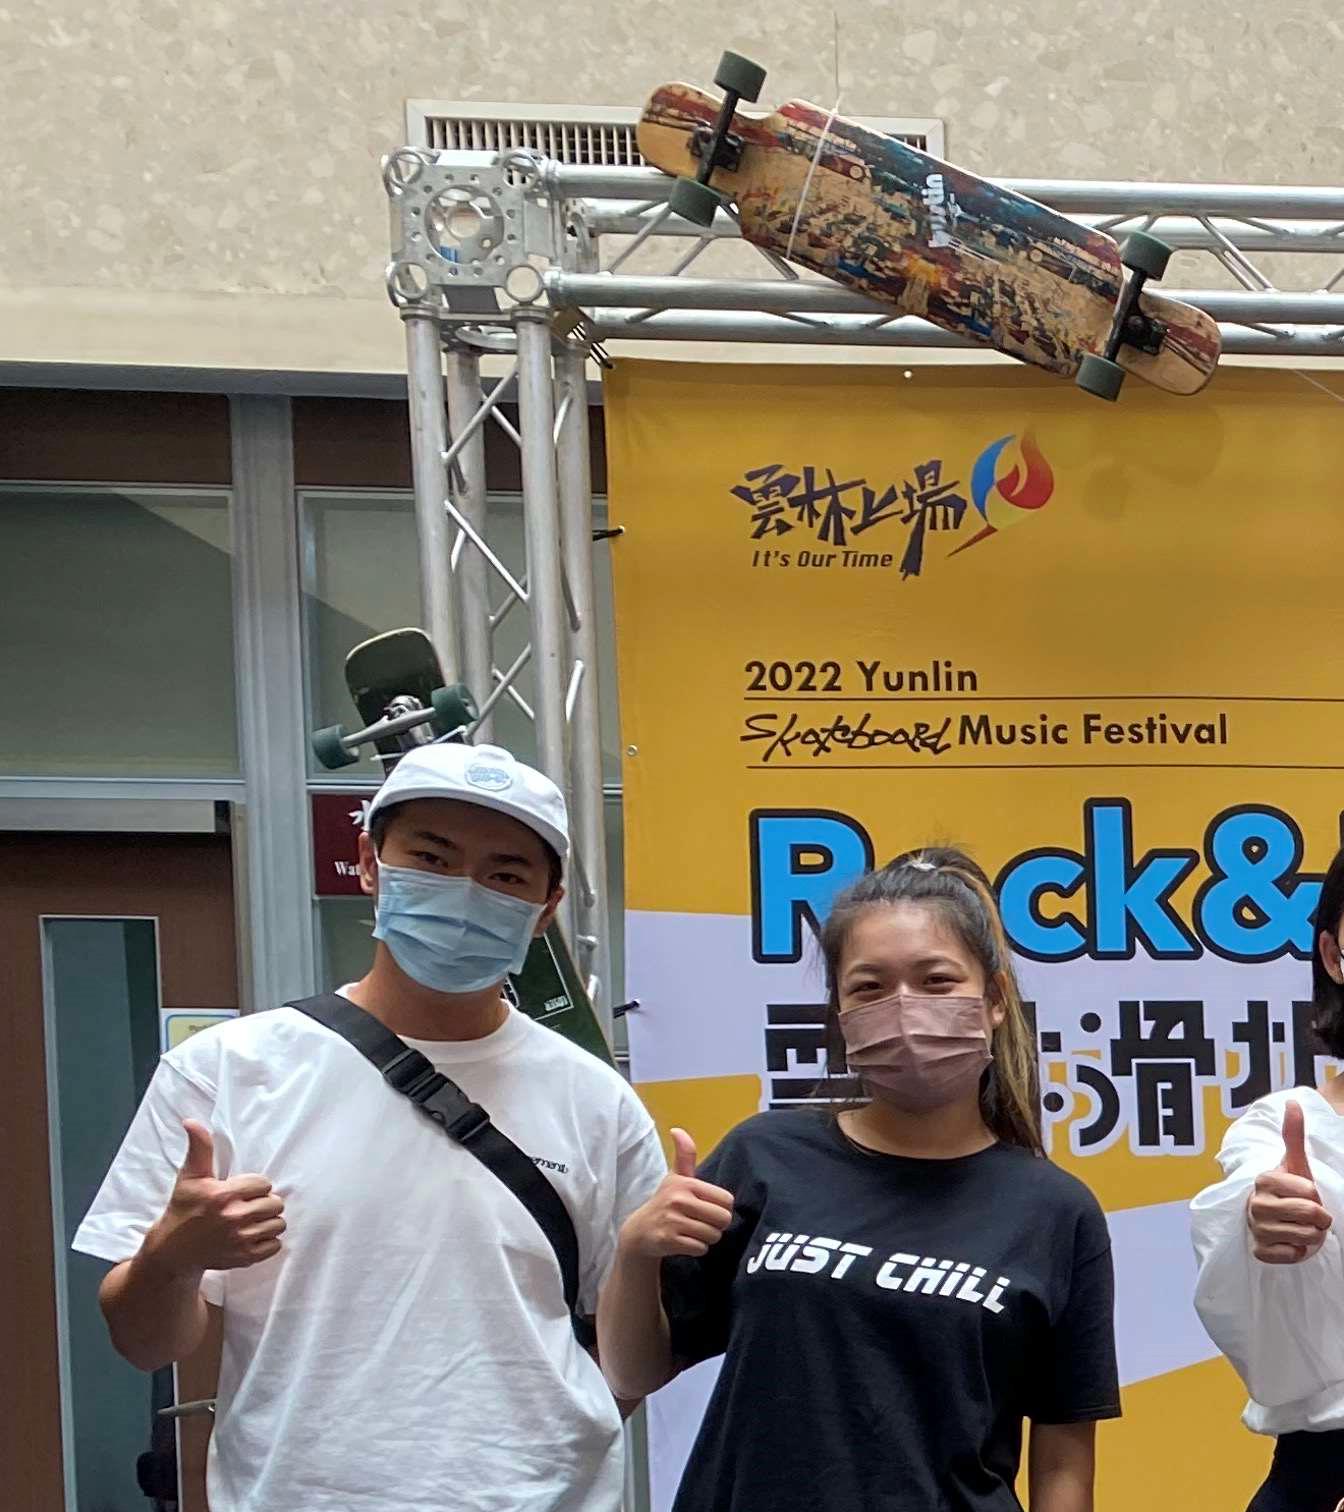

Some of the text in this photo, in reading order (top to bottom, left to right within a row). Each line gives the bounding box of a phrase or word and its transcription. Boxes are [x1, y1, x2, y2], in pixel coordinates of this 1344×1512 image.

[752, 548, 893, 569] It's Our Time
[744, 660, 978, 692] 2022 Yunlin
[958, 713, 1069, 746] Music
[1082, 713, 1228, 746] Festival
[747, 1231, 1012, 1314] JUST CHILL
